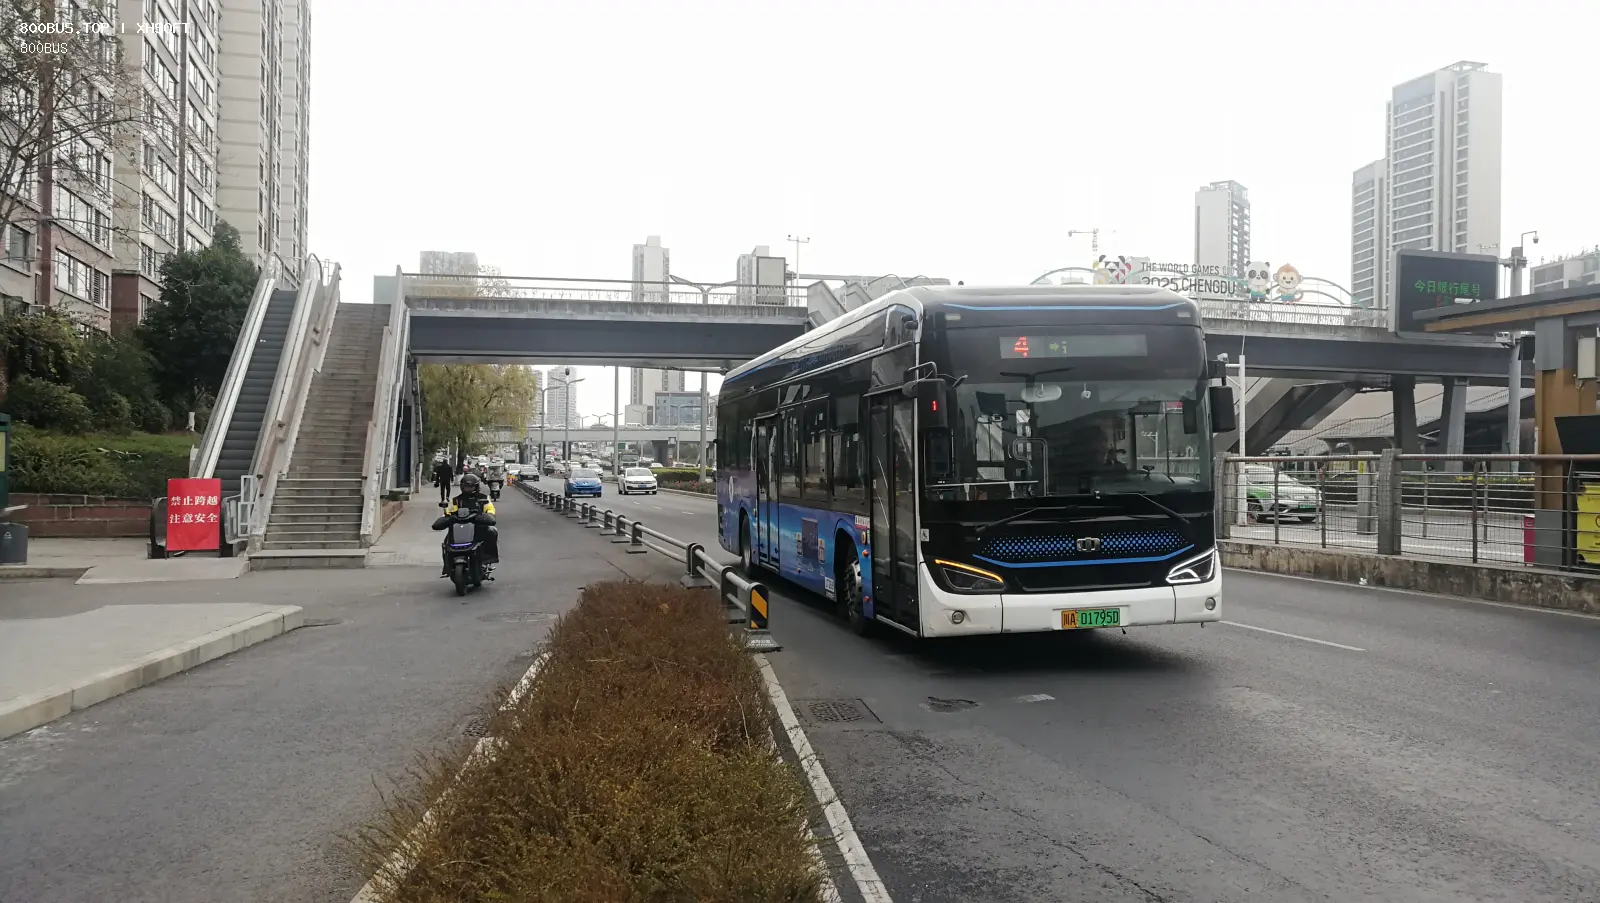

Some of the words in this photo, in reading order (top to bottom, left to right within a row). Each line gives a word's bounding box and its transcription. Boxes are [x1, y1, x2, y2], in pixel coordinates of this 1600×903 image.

[1140, 261, 1157, 272] THE
[1159, 262, 1189, 273] WORLD
[1191, 264, 1220, 276] GAMES
[1181, 277, 1235, 295] CHENGDU
[1414, 279, 1481, 297] 今日限行尾号
[1014, 336, 1029, 357] 4
[171, 496, 218, 506] 禁止跨越
[170, 513, 218, 524] 注意安全
